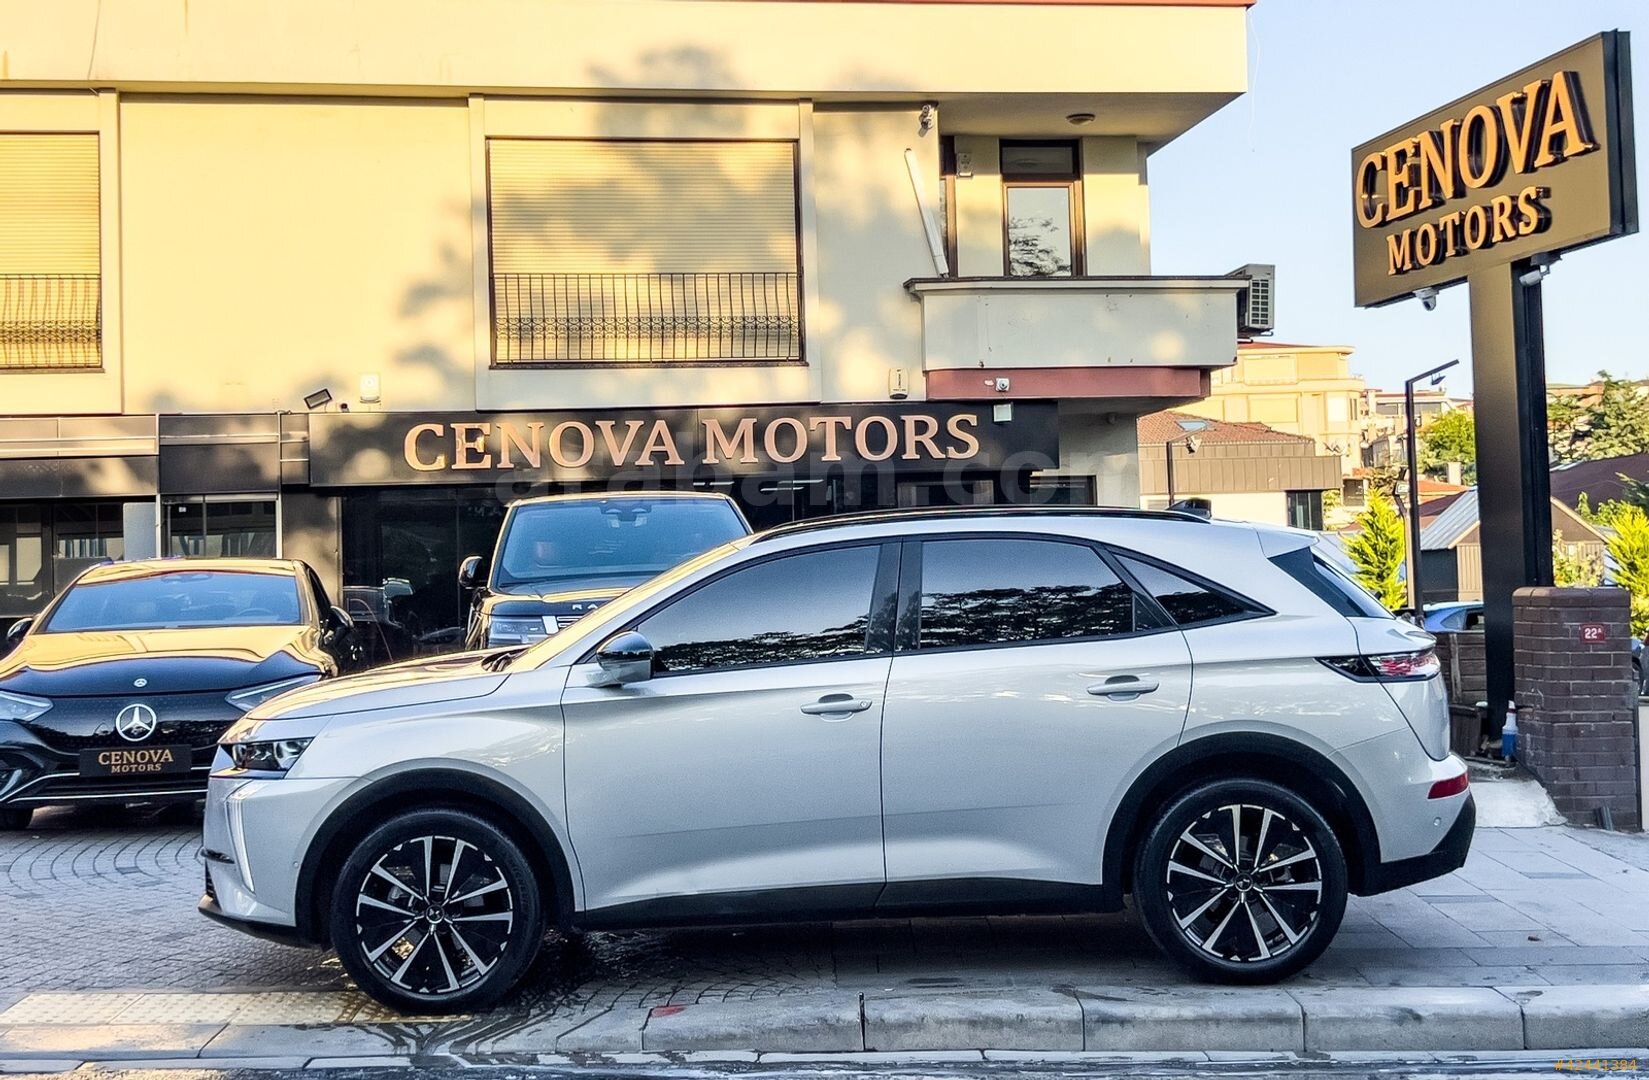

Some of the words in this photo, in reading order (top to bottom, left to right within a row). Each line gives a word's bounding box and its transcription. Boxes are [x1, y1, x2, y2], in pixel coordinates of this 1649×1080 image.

[1356, 70, 1600, 229] CENOVA
[1386, 186, 1551, 276] MOTORS
[404, 419, 685, 471] CENOVA
[701, 414, 980, 464] MOTORS
[98, 749, 174, 765] CENOVA
[111, 763, 162, 773] MOTORS
